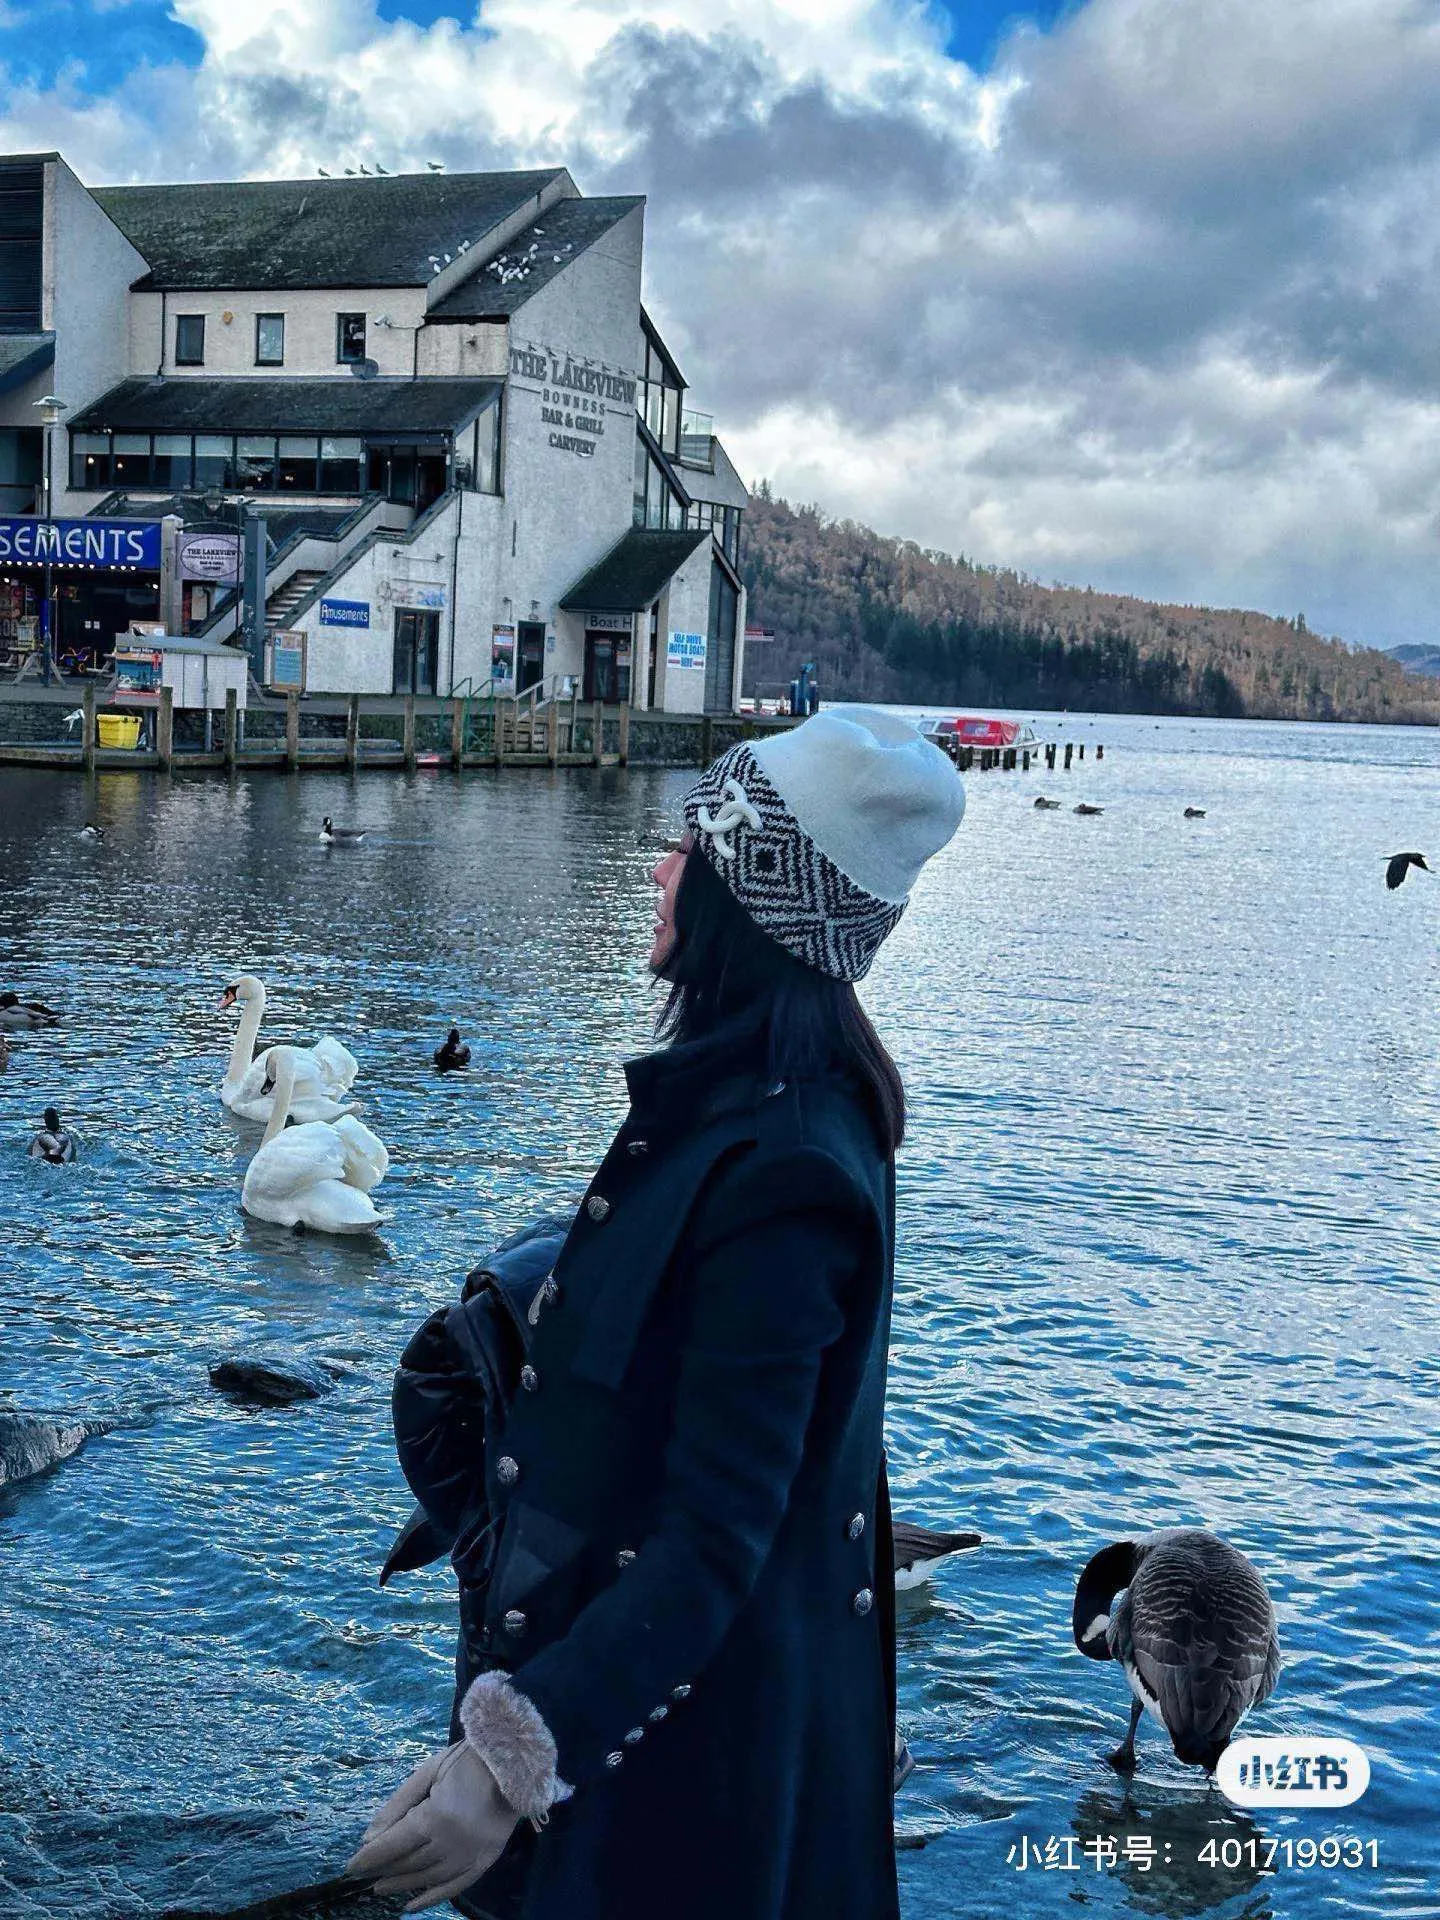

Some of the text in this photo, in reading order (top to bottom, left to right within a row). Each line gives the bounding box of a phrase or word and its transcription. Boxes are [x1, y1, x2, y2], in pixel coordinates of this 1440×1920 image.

[510, 348, 637, 404] THE LAKEVIEW
[542, 388, 606, 416] BOWNESS
[542, 407, 604, 435] BAR & GRILL
[549, 432, 596, 455] CARVERY
[0, 525, 144, 561] SEMENTS
[321, 604, 368, 622] Amusements
[591, 616, 617, 628] Boat
